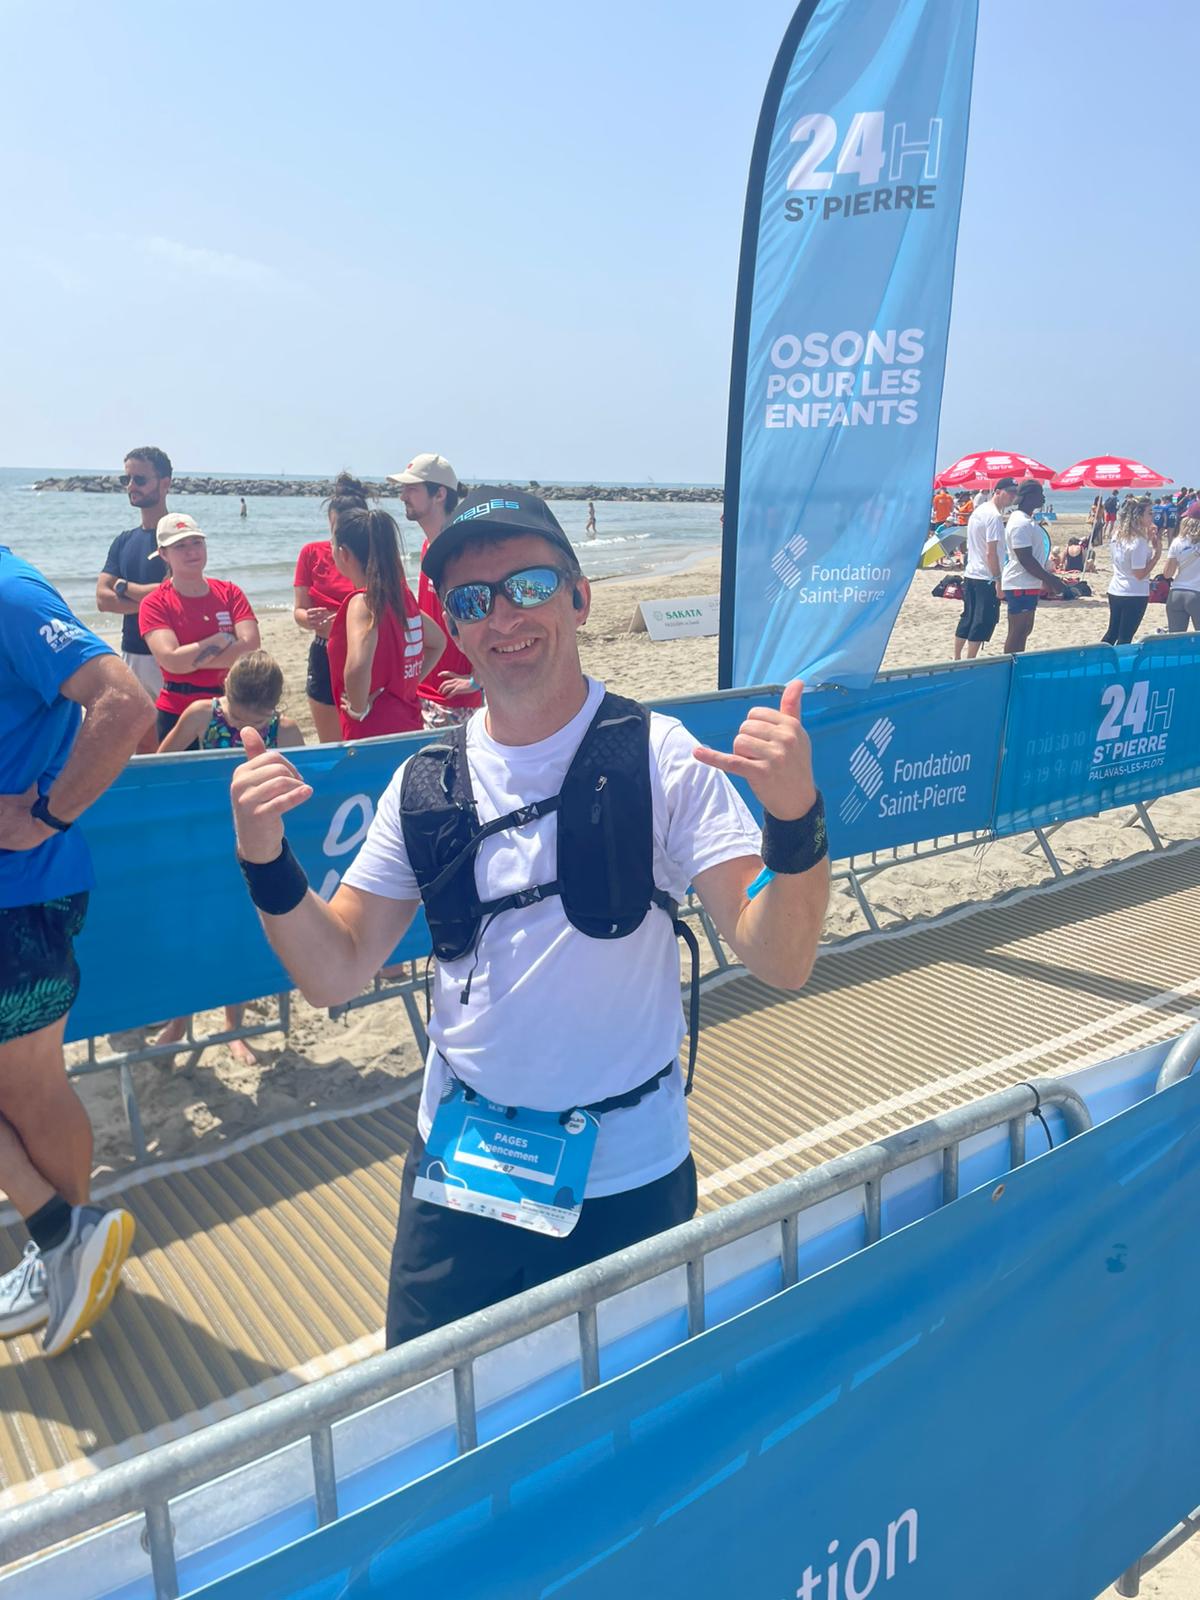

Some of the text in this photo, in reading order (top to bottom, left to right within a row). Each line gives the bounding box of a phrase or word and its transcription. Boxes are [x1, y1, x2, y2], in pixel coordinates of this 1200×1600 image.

[823, 185, 937, 221] PIERRE
[770, 328, 925, 369] OSONS
[766, 368, 921, 399] POUR LES
[765, 399, 918, 428] ENFANTS
[811, 563, 891, 582] Fondation
[799, 586, 885, 604] Saint-Pierre
[665, 609, 703, 620] SAKATA
[1112, 733, 1168, 760] PIERRE
[893, 750, 972, 784] Fondation
[1088, 757, 1164, 781] PALAVAS-LES-FLOTS
[878, 784, 967, 818] Saint-Pierre
[477, 1139, 539, 1164] Agencement
[494, 1132, 529, 1149] PAGES
